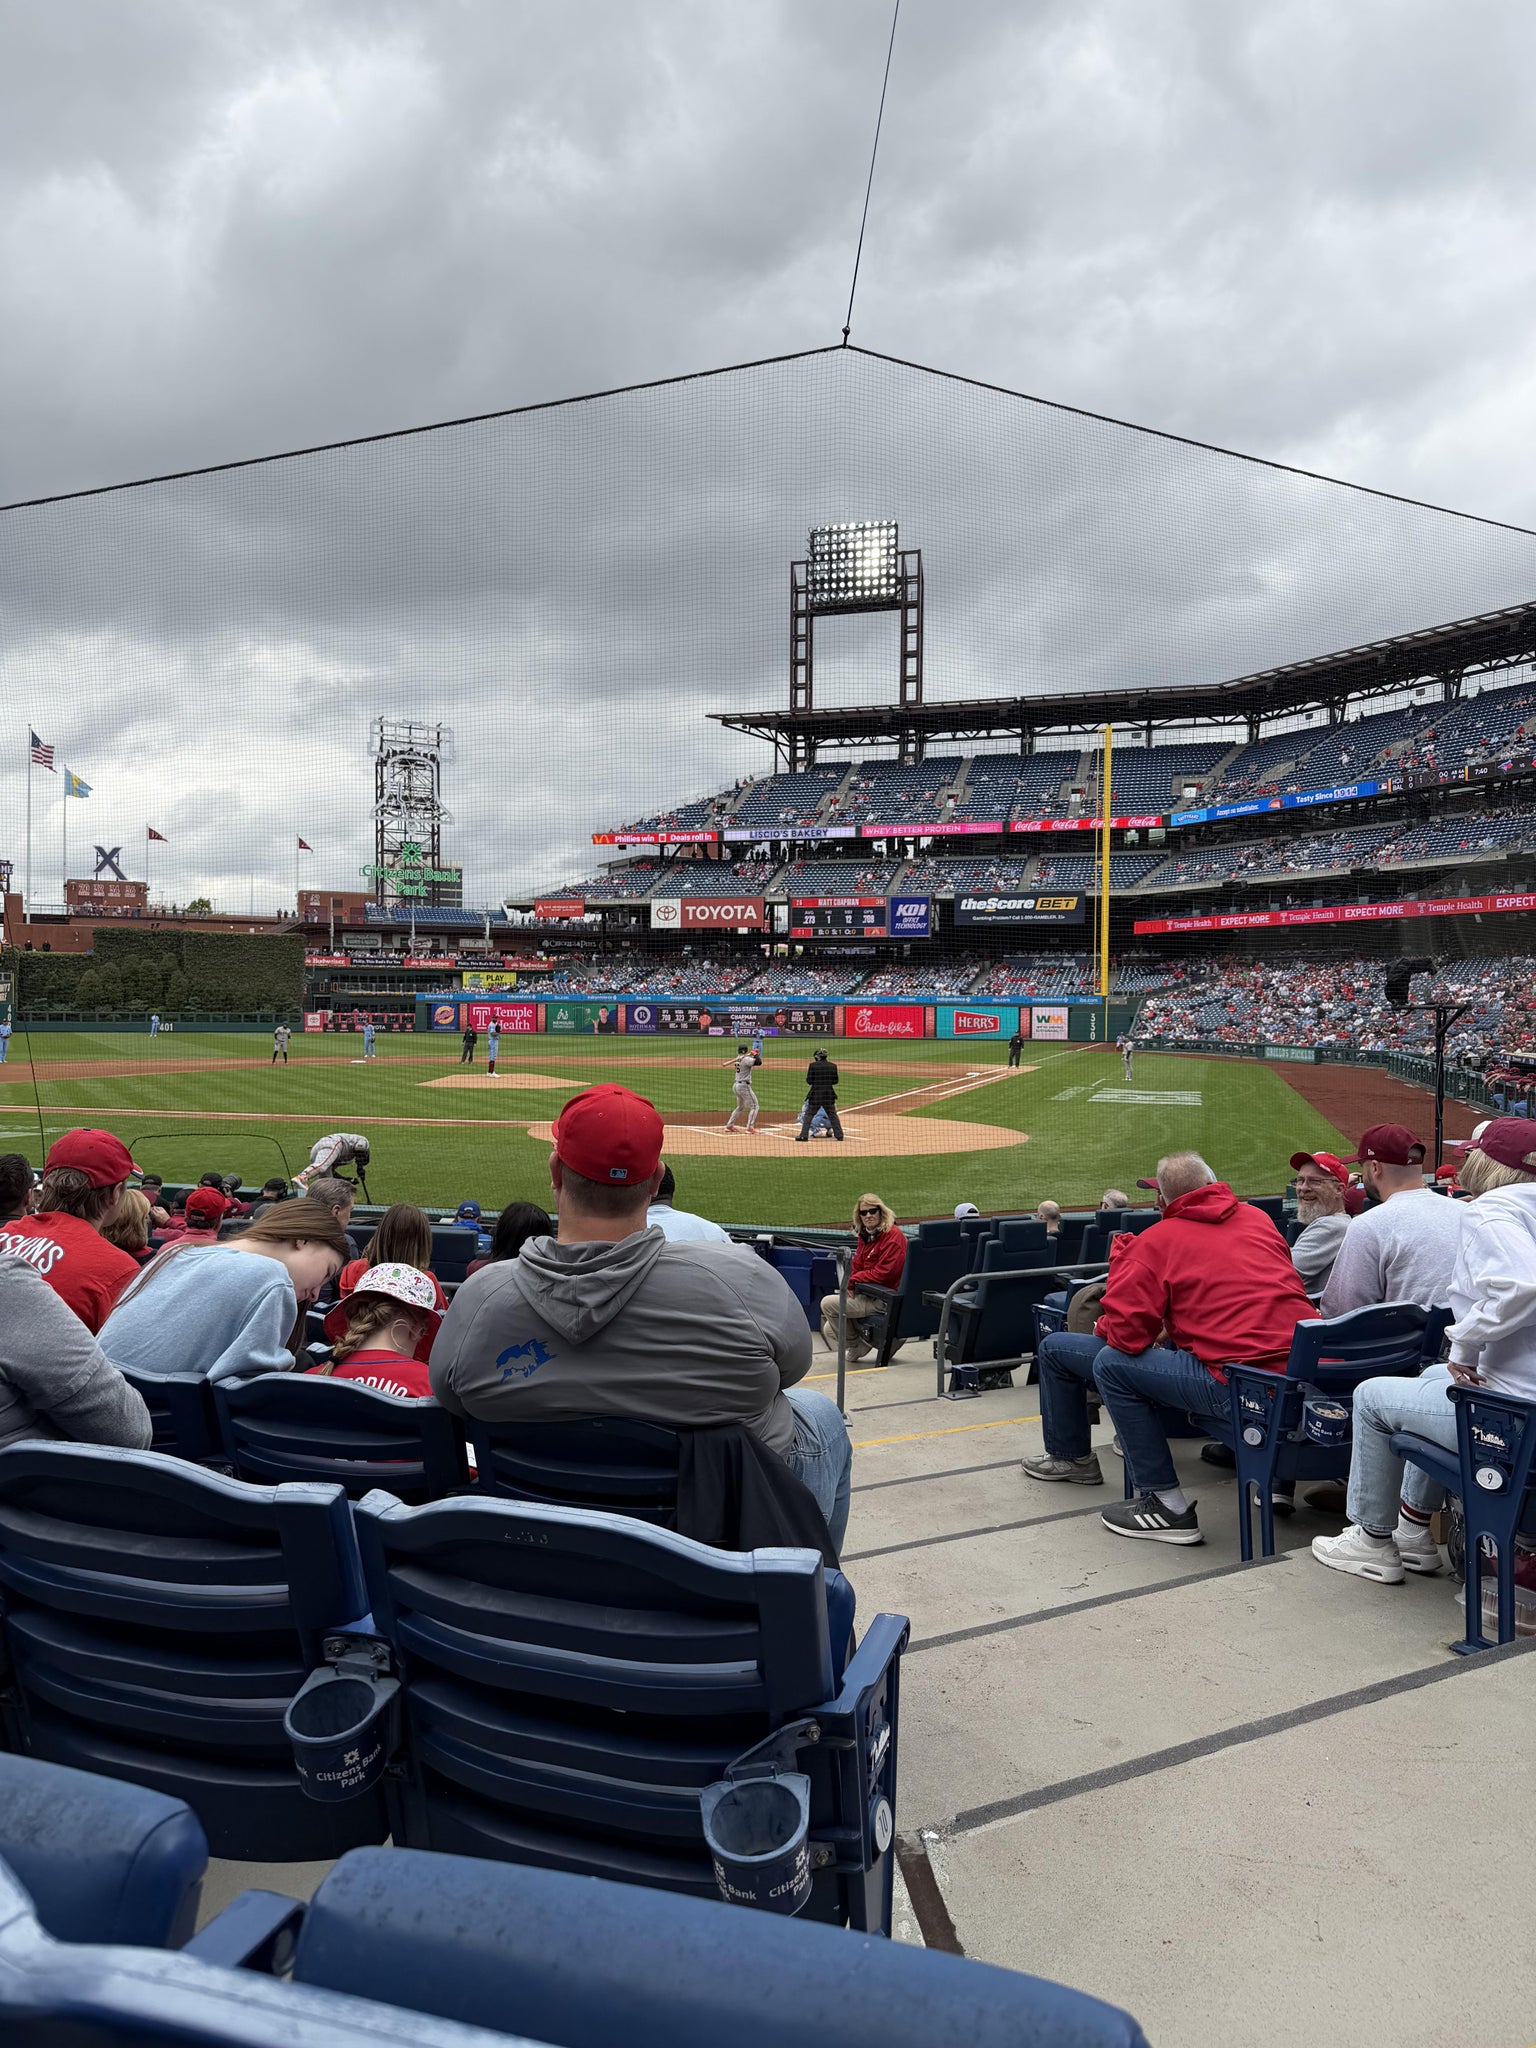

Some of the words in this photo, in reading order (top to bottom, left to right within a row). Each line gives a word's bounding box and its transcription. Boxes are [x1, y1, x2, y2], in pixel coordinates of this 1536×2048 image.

[1296, 795, 1314, 805] Tasty
[1315, 793, 1333, 802] Since
[1334, 787, 1358, 800] 1914
[1015, 821, 1042, 831] Coca-Cola
[1052, 819, 1079, 830] Coca-Cola
[1128, 816, 1157, 826] Coca-Cola
[750, 830, 788, 839] LISCIO'S
[791, 829, 828, 838] BAKERY
[866, 827, 891, 835] WHEY
[892, 826, 922, 834] BETTER
[924, 825, 961, 833] PROTEIN
[670, 833, 690, 841] Deals
[362, 865, 422, 880] Citizens
[424, 868, 460, 882] Bank
[395, 882, 428, 896] Park
[960, 897, 1035, 911] theScore
[1040, 898, 1074, 908] BET
[1428, 903, 1455, 913] Temple
[1457, 901, 1483, 910] Health
[1496, 896, 1536, 908] EXPECT
[685, 905, 757, 920] TOYOTA
[896, 904, 927, 916] KDI
[1345, 908, 1376, 918] EXPECT
[1378, 906, 1404, 916] MORE
[826, 915, 830, 924] 1
[845, 915, 852, 924] 12
[1220, 916, 1247, 926] EXPECT
[1249, 915, 1270, 924] MORE
[1289, 913, 1312, 922] Temple
[1313, 911, 1334, 920] Health
[1174, 922, 1192, 930] Temple
[494, 1007, 532, 1020] Temple
[1036, 1015, 1063, 1024] WM
[159, 1023, 173, 1031] 401
[855, 1010, 914, 1033] Chick-fil-A
[958, 1016, 995, 1029] HERR'S
[316, 1764, 361, 1782] Citizens
[362, 1743, 382, 1767] Bank
[341, 1771, 366, 1788] Park
[878, 1809, 888, 1838] 10
[793, 1873, 810, 1896] Park
[728, 1883, 757, 1900] Bank
